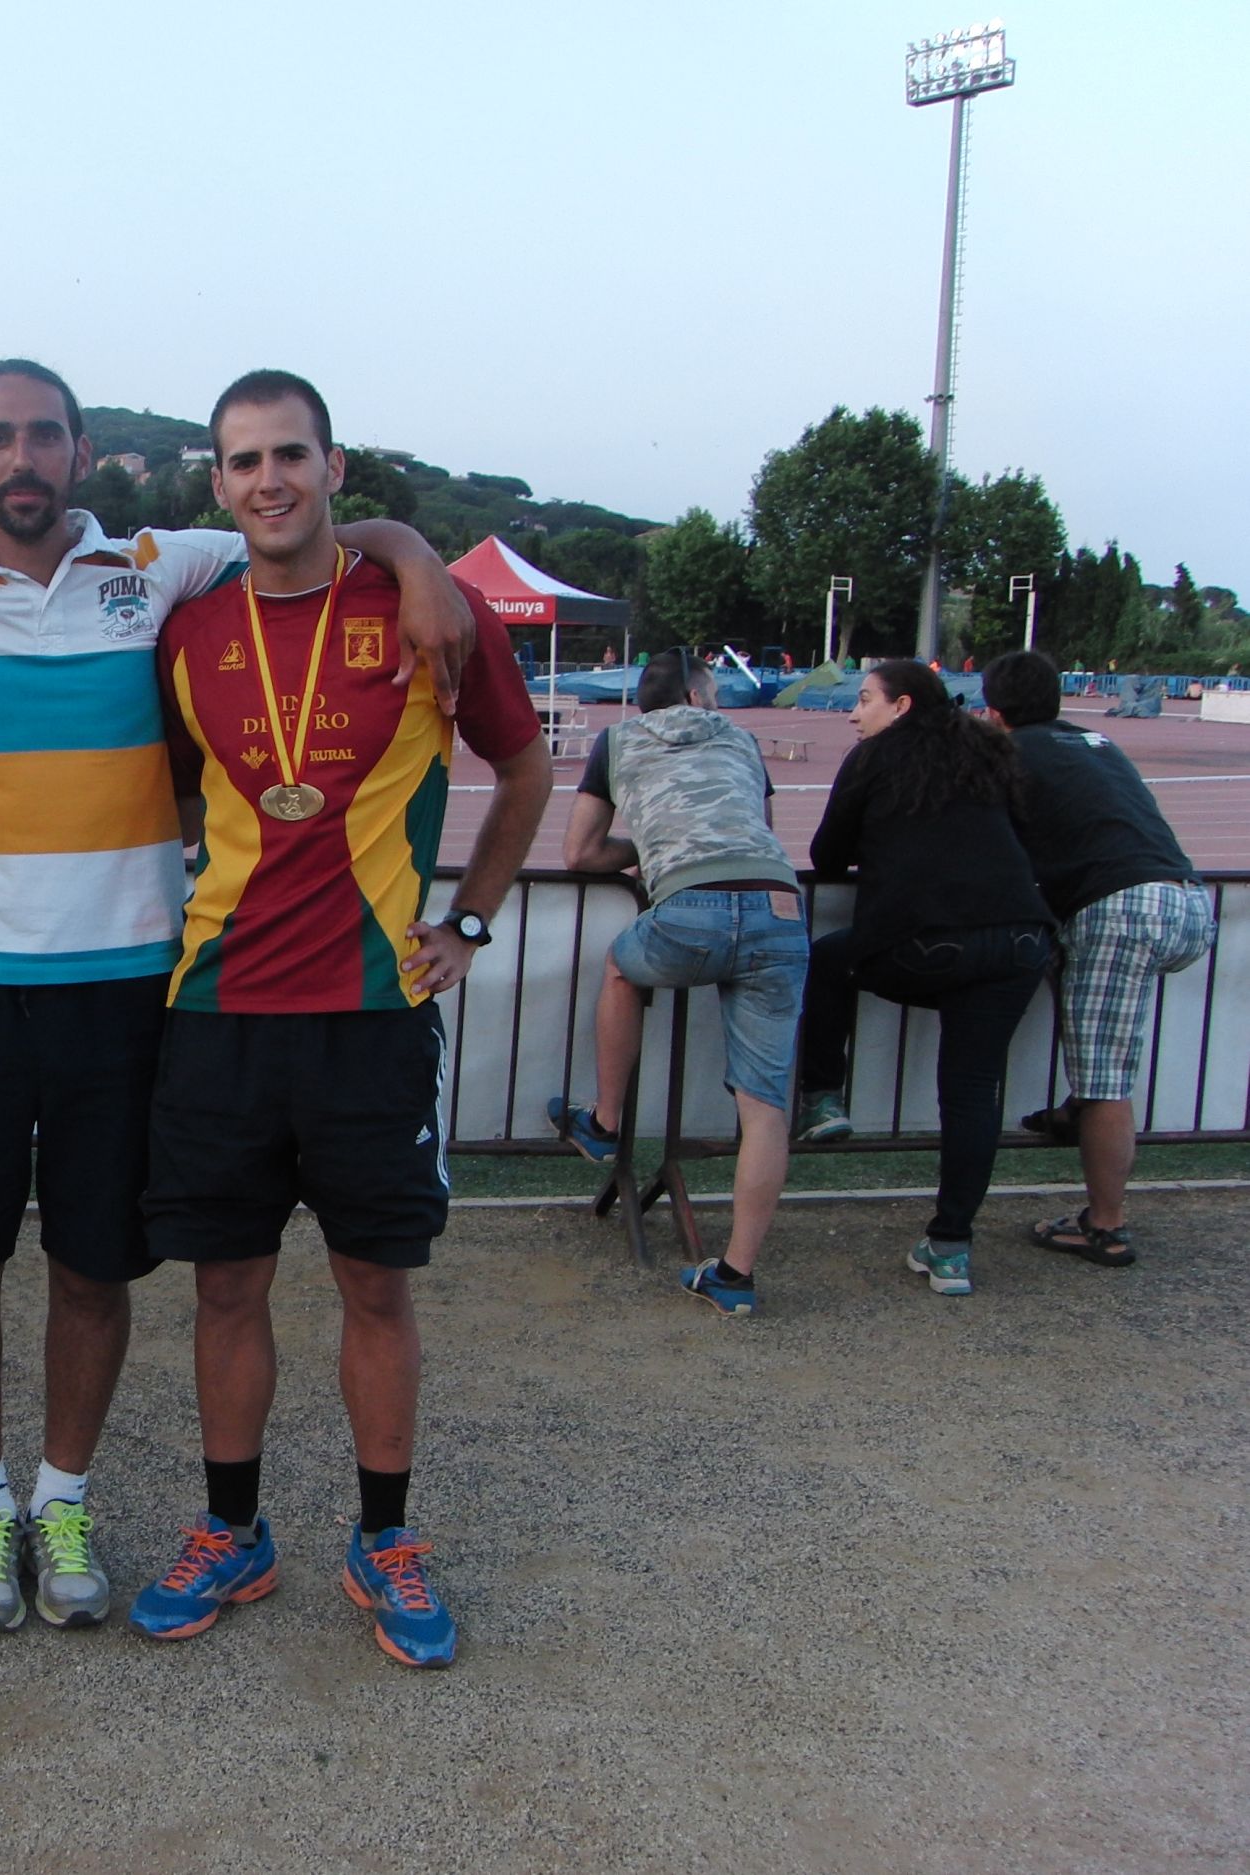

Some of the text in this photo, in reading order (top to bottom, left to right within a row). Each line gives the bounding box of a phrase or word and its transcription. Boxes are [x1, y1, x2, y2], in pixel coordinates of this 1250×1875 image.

[99, 575, 149, 604] PUMA
[284, 712, 349, 731] TRO
[307, 748, 356, 762] RURAL
